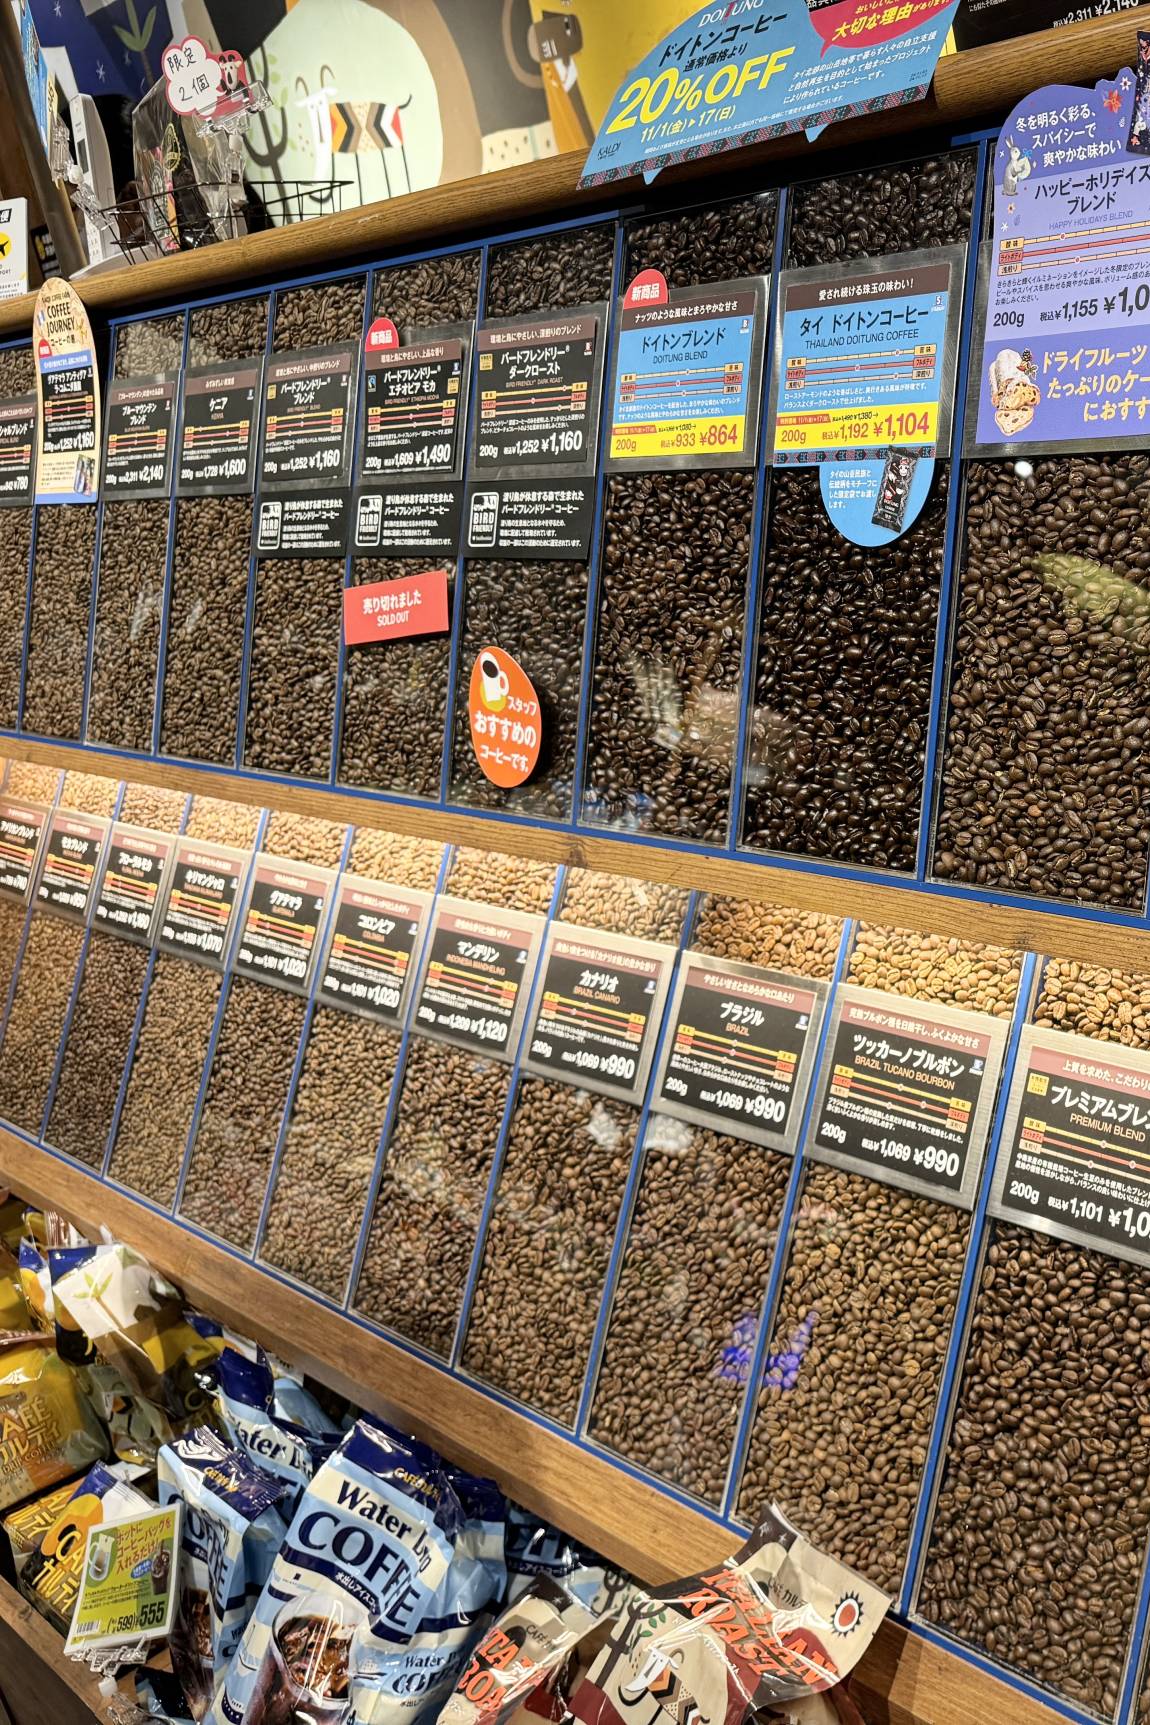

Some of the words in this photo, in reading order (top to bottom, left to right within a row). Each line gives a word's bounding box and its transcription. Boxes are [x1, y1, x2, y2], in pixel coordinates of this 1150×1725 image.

[660, 12, 787, 67] ドイトンコーヒー
[166, 47, 196, 73] 限定
[684, 42, 746, 72] 通常価格より
[179, 74, 209, 102] 2個
[606, 46, 796, 134] 20%OFF
[1016, 103, 1098, 134] 冬を明るく彩る、
[1031, 122, 1097, 151] スパイシーで
[1043, 140, 1123, 169] 爽やかな味わい
[1068, 191, 1118, 216] ブレンド
[1049, 218, 1072, 230] HAPPY
[1110, 211, 1134, 223] BLEND
[631, 283, 659, 301] 新商品
[47, 302, 71, 318] COFFEE
[635, 301, 738, 323] ナッツのような風味とまろやかな甘さ
[800, 317, 827, 337] タイ
[833, 305, 929, 334] ドイトンコーヒー
[994, 311, 1025, 327] 200g
[47, 317, 75, 337] JOURNEY
[805, 337, 845, 350] THAILAND
[847, 332, 885, 345] DOITUNG
[887, 329, 919, 341] COFFEE
[643, 328, 725, 353] ドイトンブレンド
[653, 353, 683, 364] DOITUNG
[685, 351, 708, 360] BLEND
[1043, 344, 1148, 374] ドライフルーツ
[509, 362, 560, 379] ダークロースト
[388, 379, 421, 397] エチオピア
[616, 438, 636, 451] 200g
[699, 424, 737, 446] ¥864
[781, 428, 806, 444] 200g
[874, 412, 929, 443] ¥1,104
[480, 445, 498, 458] 200g
[541, 431, 582, 456] ¥1,160
[309, 449, 340, 471] ¥1,160
[365, 456, 382, 470] 200g
[473, 512, 494, 525] BIRD
[363, 590, 421, 615] 売り切れました
[377, 614, 396, 627] SOLD
[397, 611, 409, 623] OUT
[508, 696, 537, 716] スタッフ
[474, 711, 536, 748] おすすめの
[720, 1002, 764, 1026] ブラジル
[854, 1034, 964, 1077] ツッカーノブルボン
[855, 1055, 881, 1071] BRAZIL
[883, 1063, 914, 1079] TUCANO
[915, 1072, 955, 1089] BOURBON
[666, 1077, 688, 1096] 200g
[745, 1095, 785, 1123] ¥990
[1070, 1113, 1112, 1133] PREMIUM
[1114, 1126, 1146, 1142] BLEND
[821, 1122, 847, 1143] 200g
[913, 1146, 959, 1176] ¥990
[1010, 1181, 1040, 1204] 200g
[337, 1479, 412, 1540] Water
